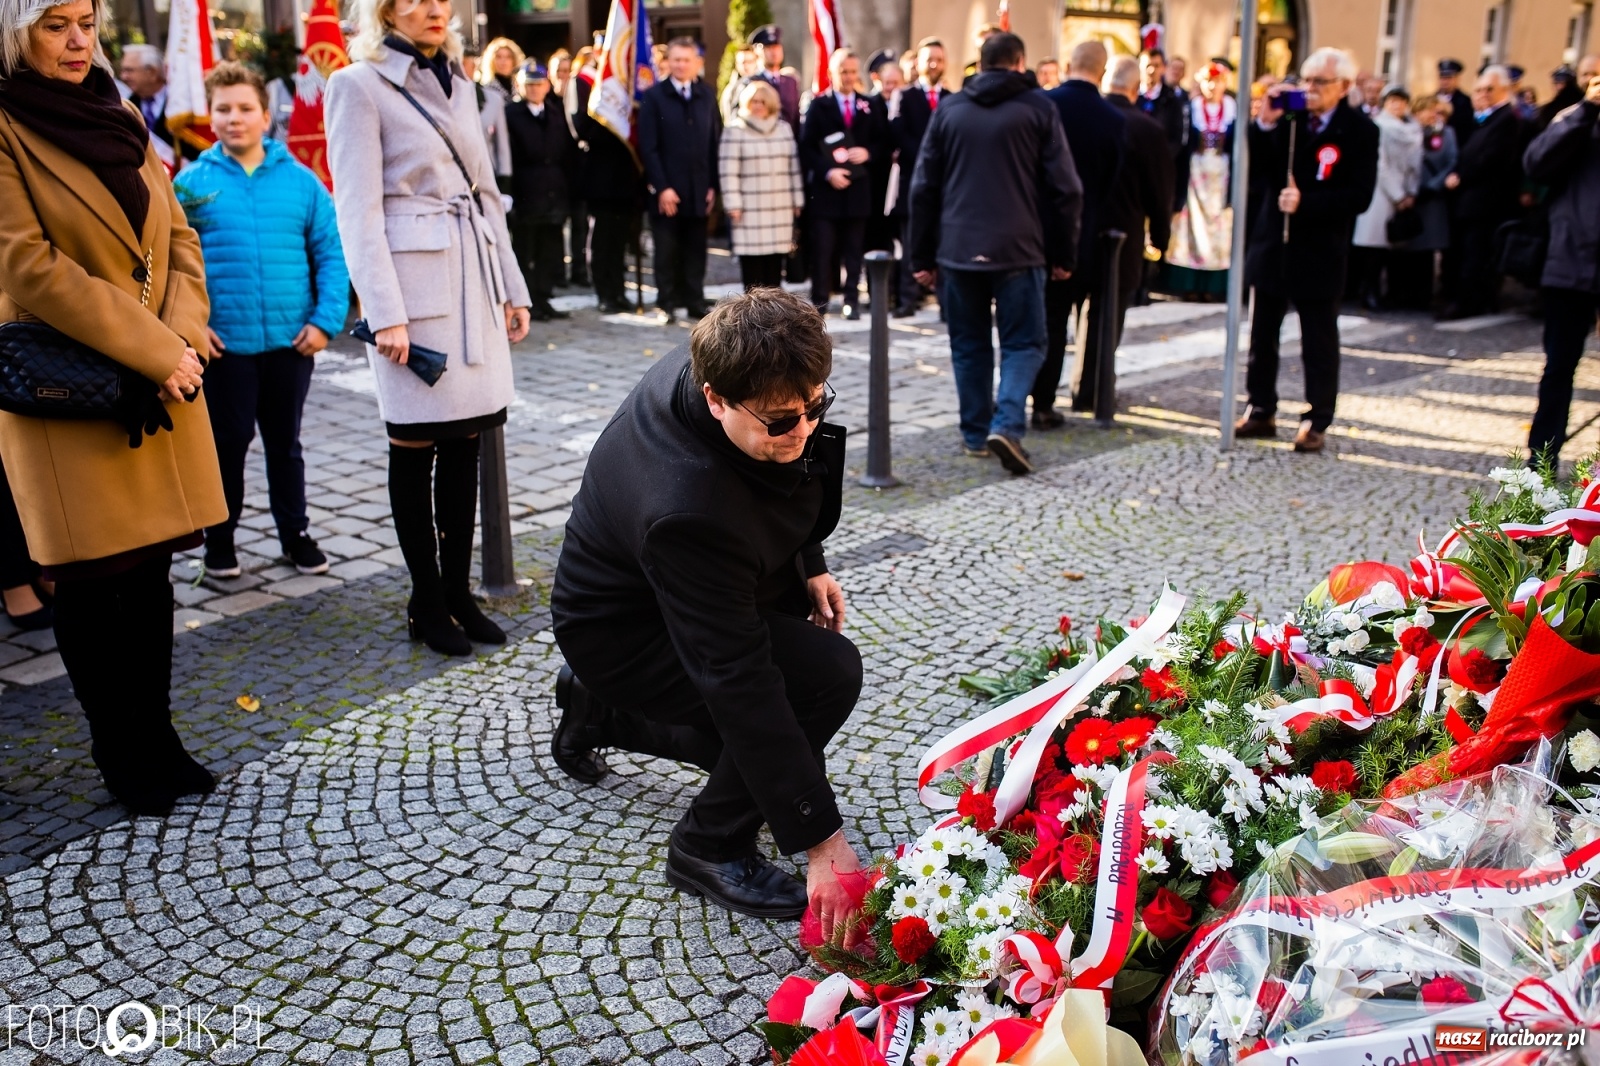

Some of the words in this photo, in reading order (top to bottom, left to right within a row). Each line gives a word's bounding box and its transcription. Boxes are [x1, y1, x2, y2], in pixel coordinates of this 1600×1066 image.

[1108, 802, 1135, 886] RACIBORZU
[1471, 879, 1483, 899] i
[1106, 906, 1124, 923] W
